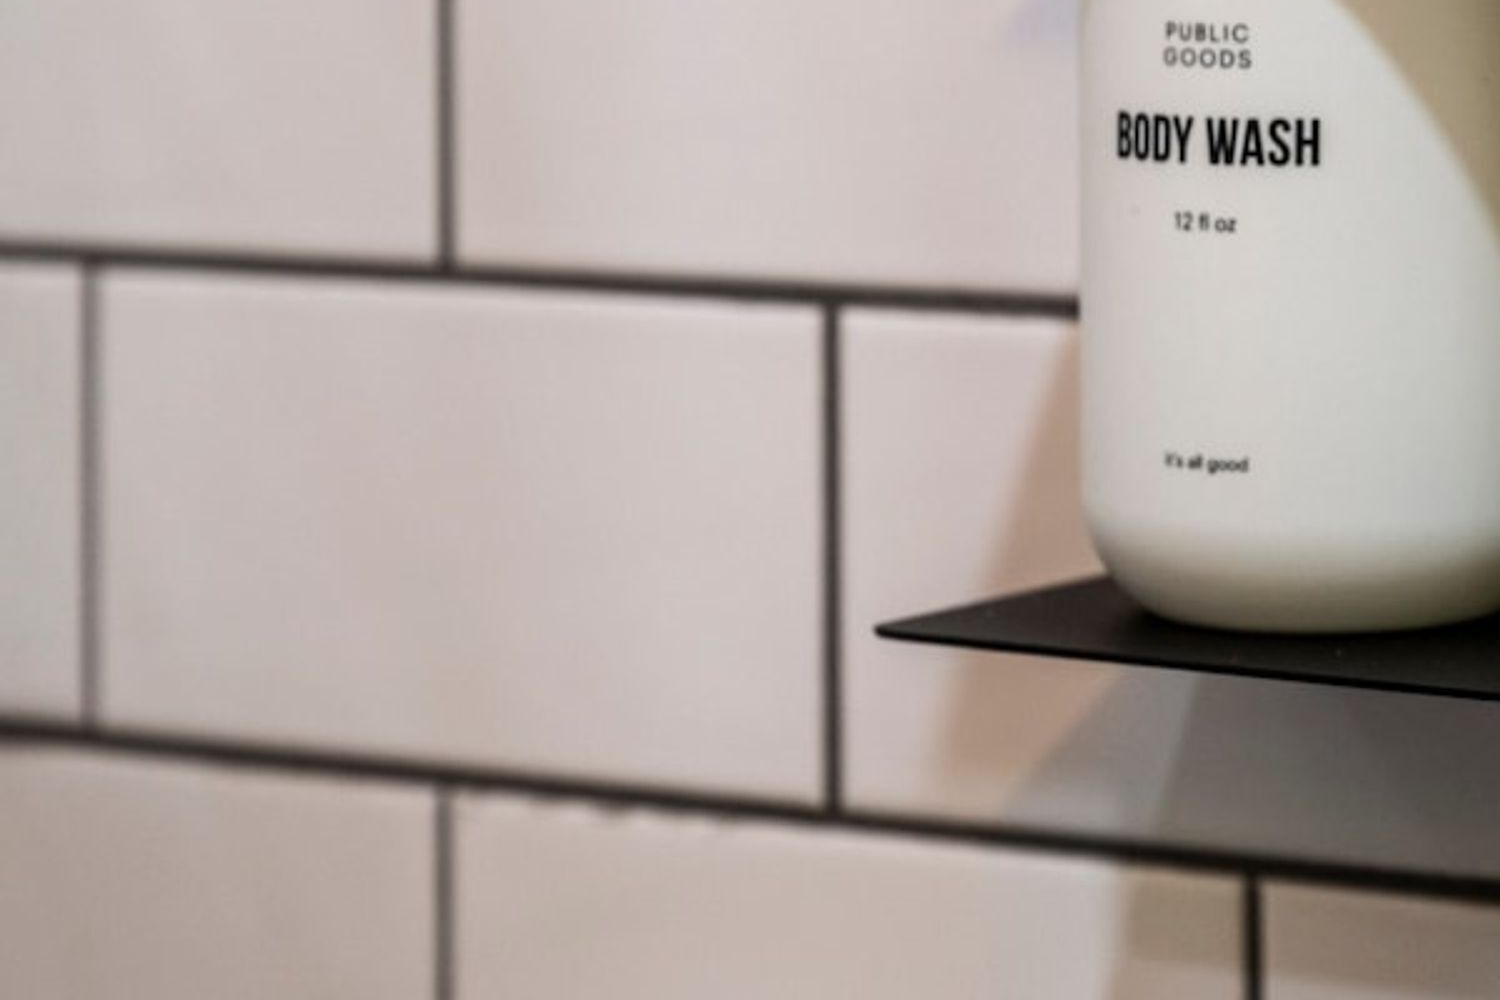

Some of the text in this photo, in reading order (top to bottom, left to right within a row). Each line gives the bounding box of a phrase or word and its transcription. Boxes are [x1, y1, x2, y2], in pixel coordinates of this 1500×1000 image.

[1165, 21, 1249, 43] PUBLIC
[1163, 47, 1253, 70] GOODS
[1117, 111, 1321, 167] BODY WASH
[1174, 211, 1237, 234] 12 fl oz
